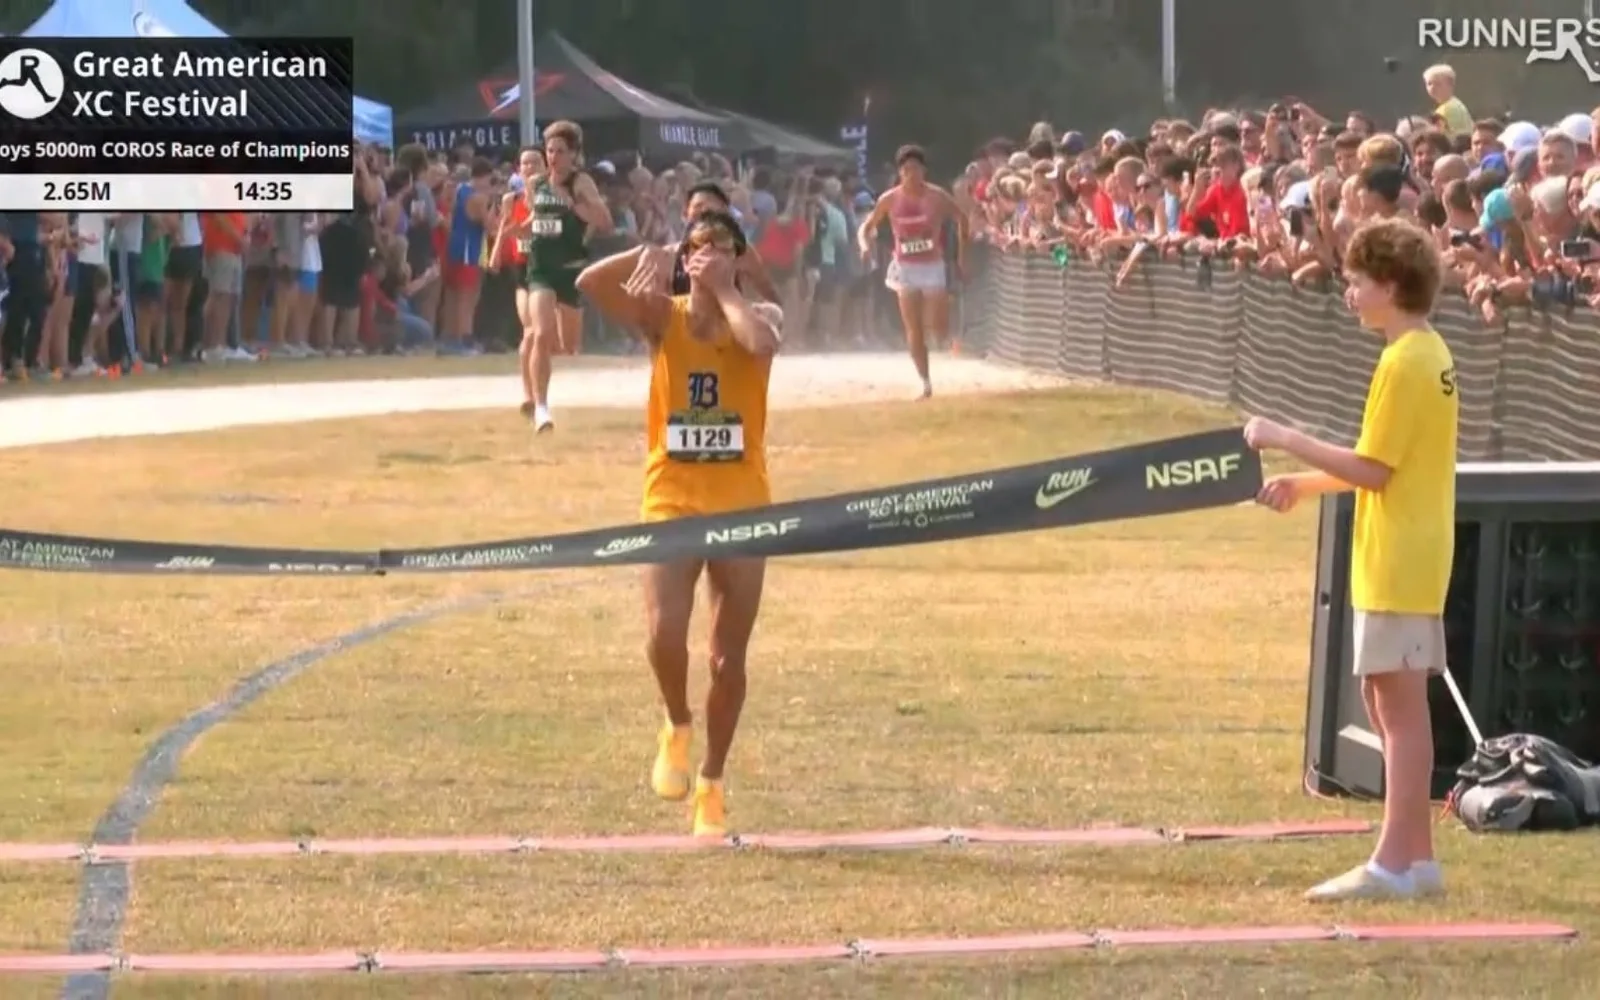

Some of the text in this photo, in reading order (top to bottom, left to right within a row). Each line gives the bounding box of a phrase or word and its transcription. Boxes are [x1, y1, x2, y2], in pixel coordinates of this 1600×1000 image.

[687, 371, 719, 410] B
[679, 427, 732, 449] 1129
[1046, 467, 1093, 491] RUN
[1145, 453, 1241, 490] NSAF
[845, 479, 994, 513] GREAT AMERICAN
[894, 493, 972, 514] FESTIVAL
[606, 533, 653, 551] RUN
[705, 517, 802, 545] NSAF
